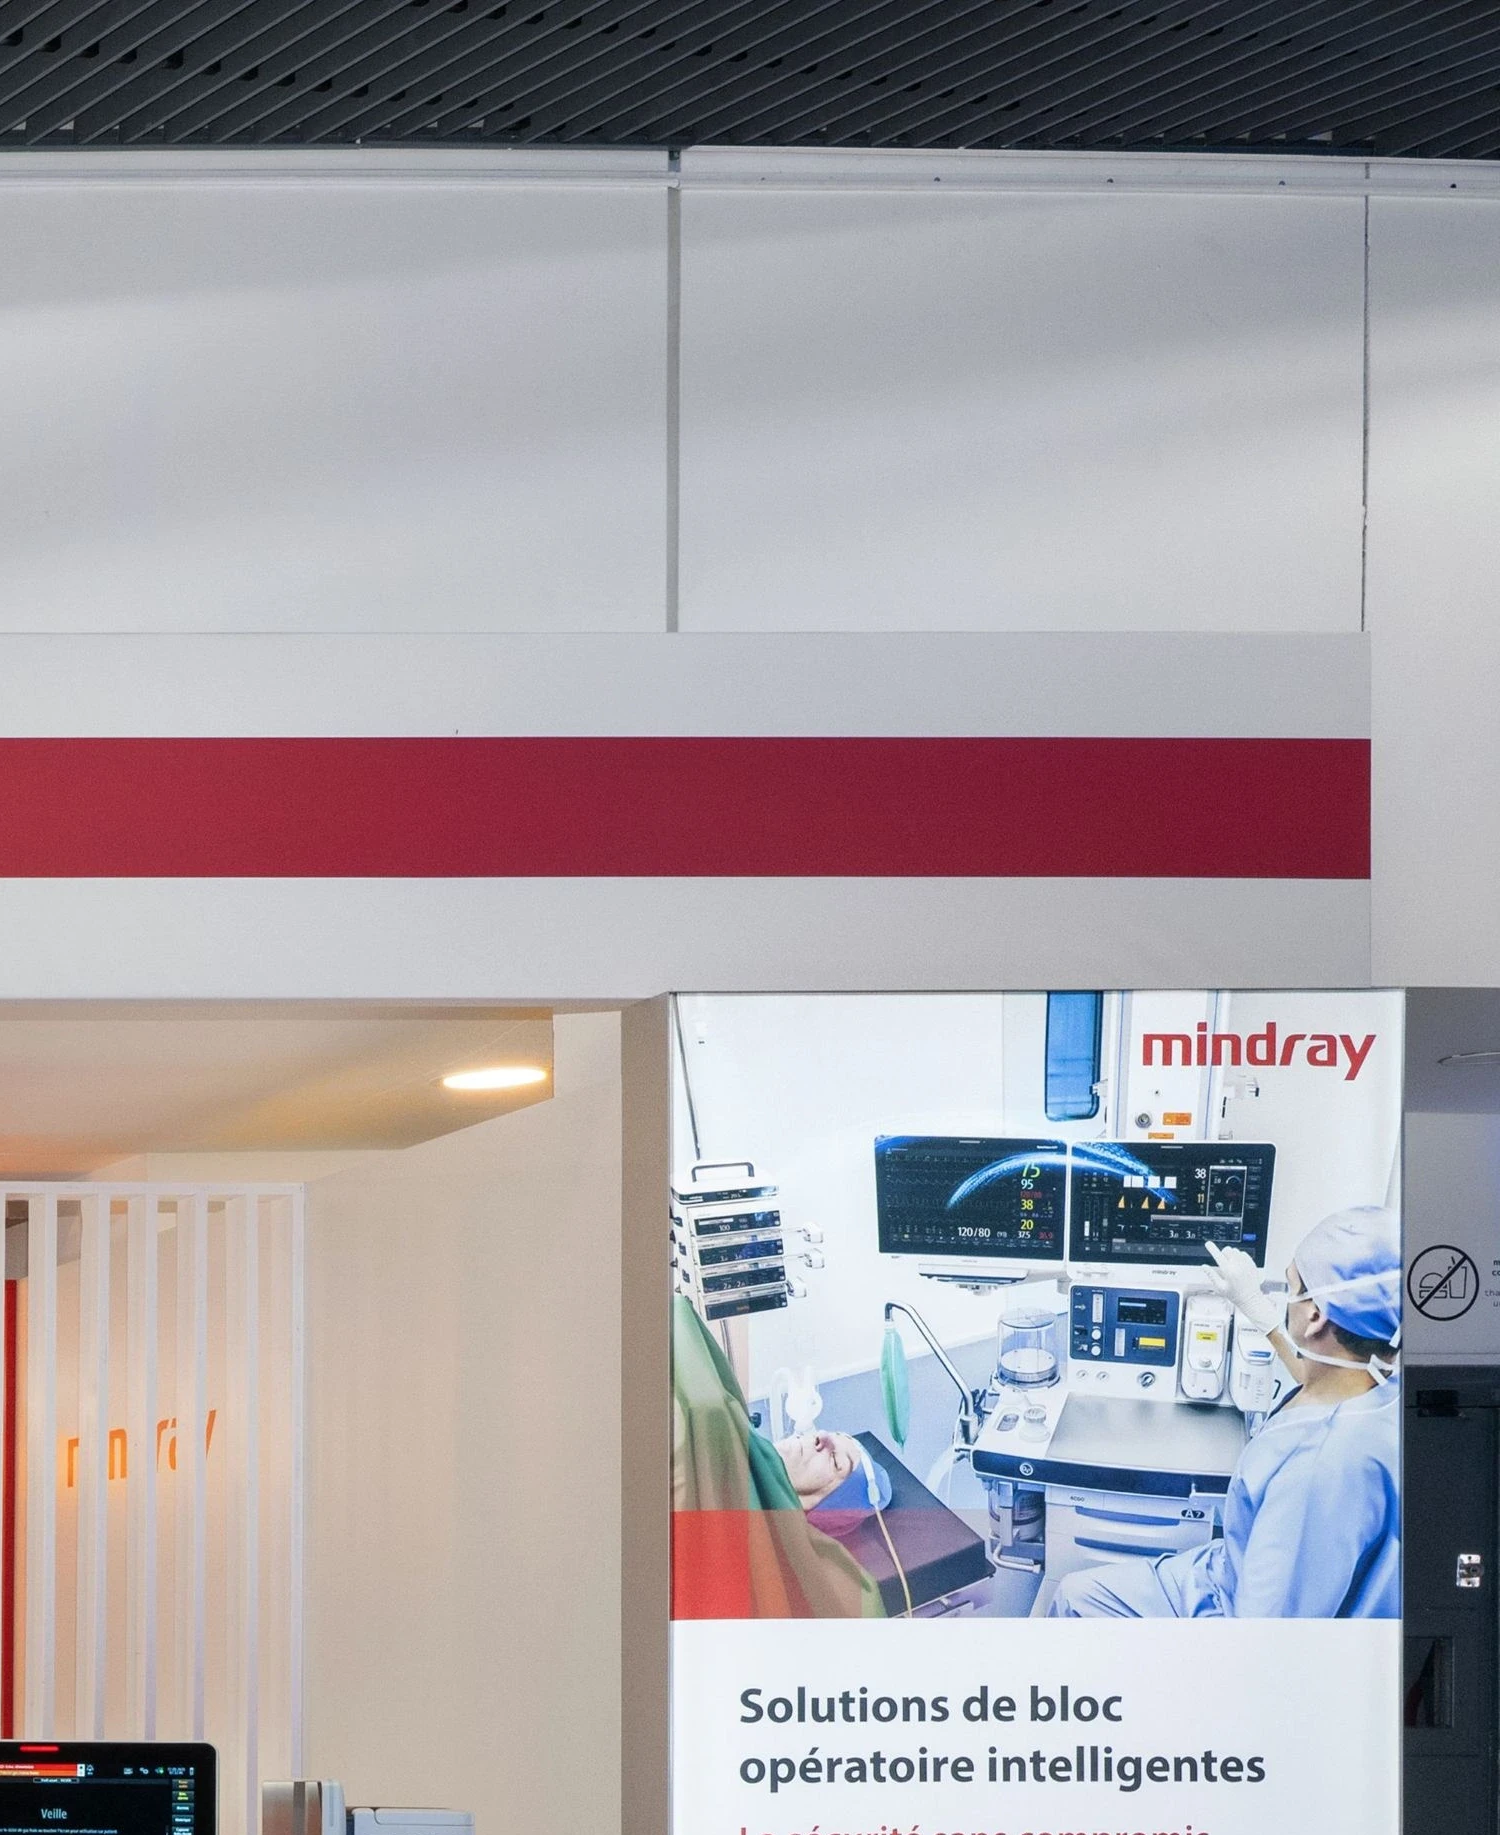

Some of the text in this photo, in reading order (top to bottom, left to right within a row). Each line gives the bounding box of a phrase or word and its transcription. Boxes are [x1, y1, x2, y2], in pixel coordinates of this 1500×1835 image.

[1142, 1021, 1377, 1081] mindray
[1195, 1168, 1206, 1179] 38
[1020, 1179, 1033, 1190] 95
[1020, 1200, 1033, 1210] 38
[1020, 1220, 1034, 1230] 20
[958, 1227, 991, 1238] 120/80
[740, 1686, 1122, 1723] Solutions de bloc
[740, 1746, 1265, 1793] opératoire intelligentes
[41, 1808, 68, 1820] Veille
